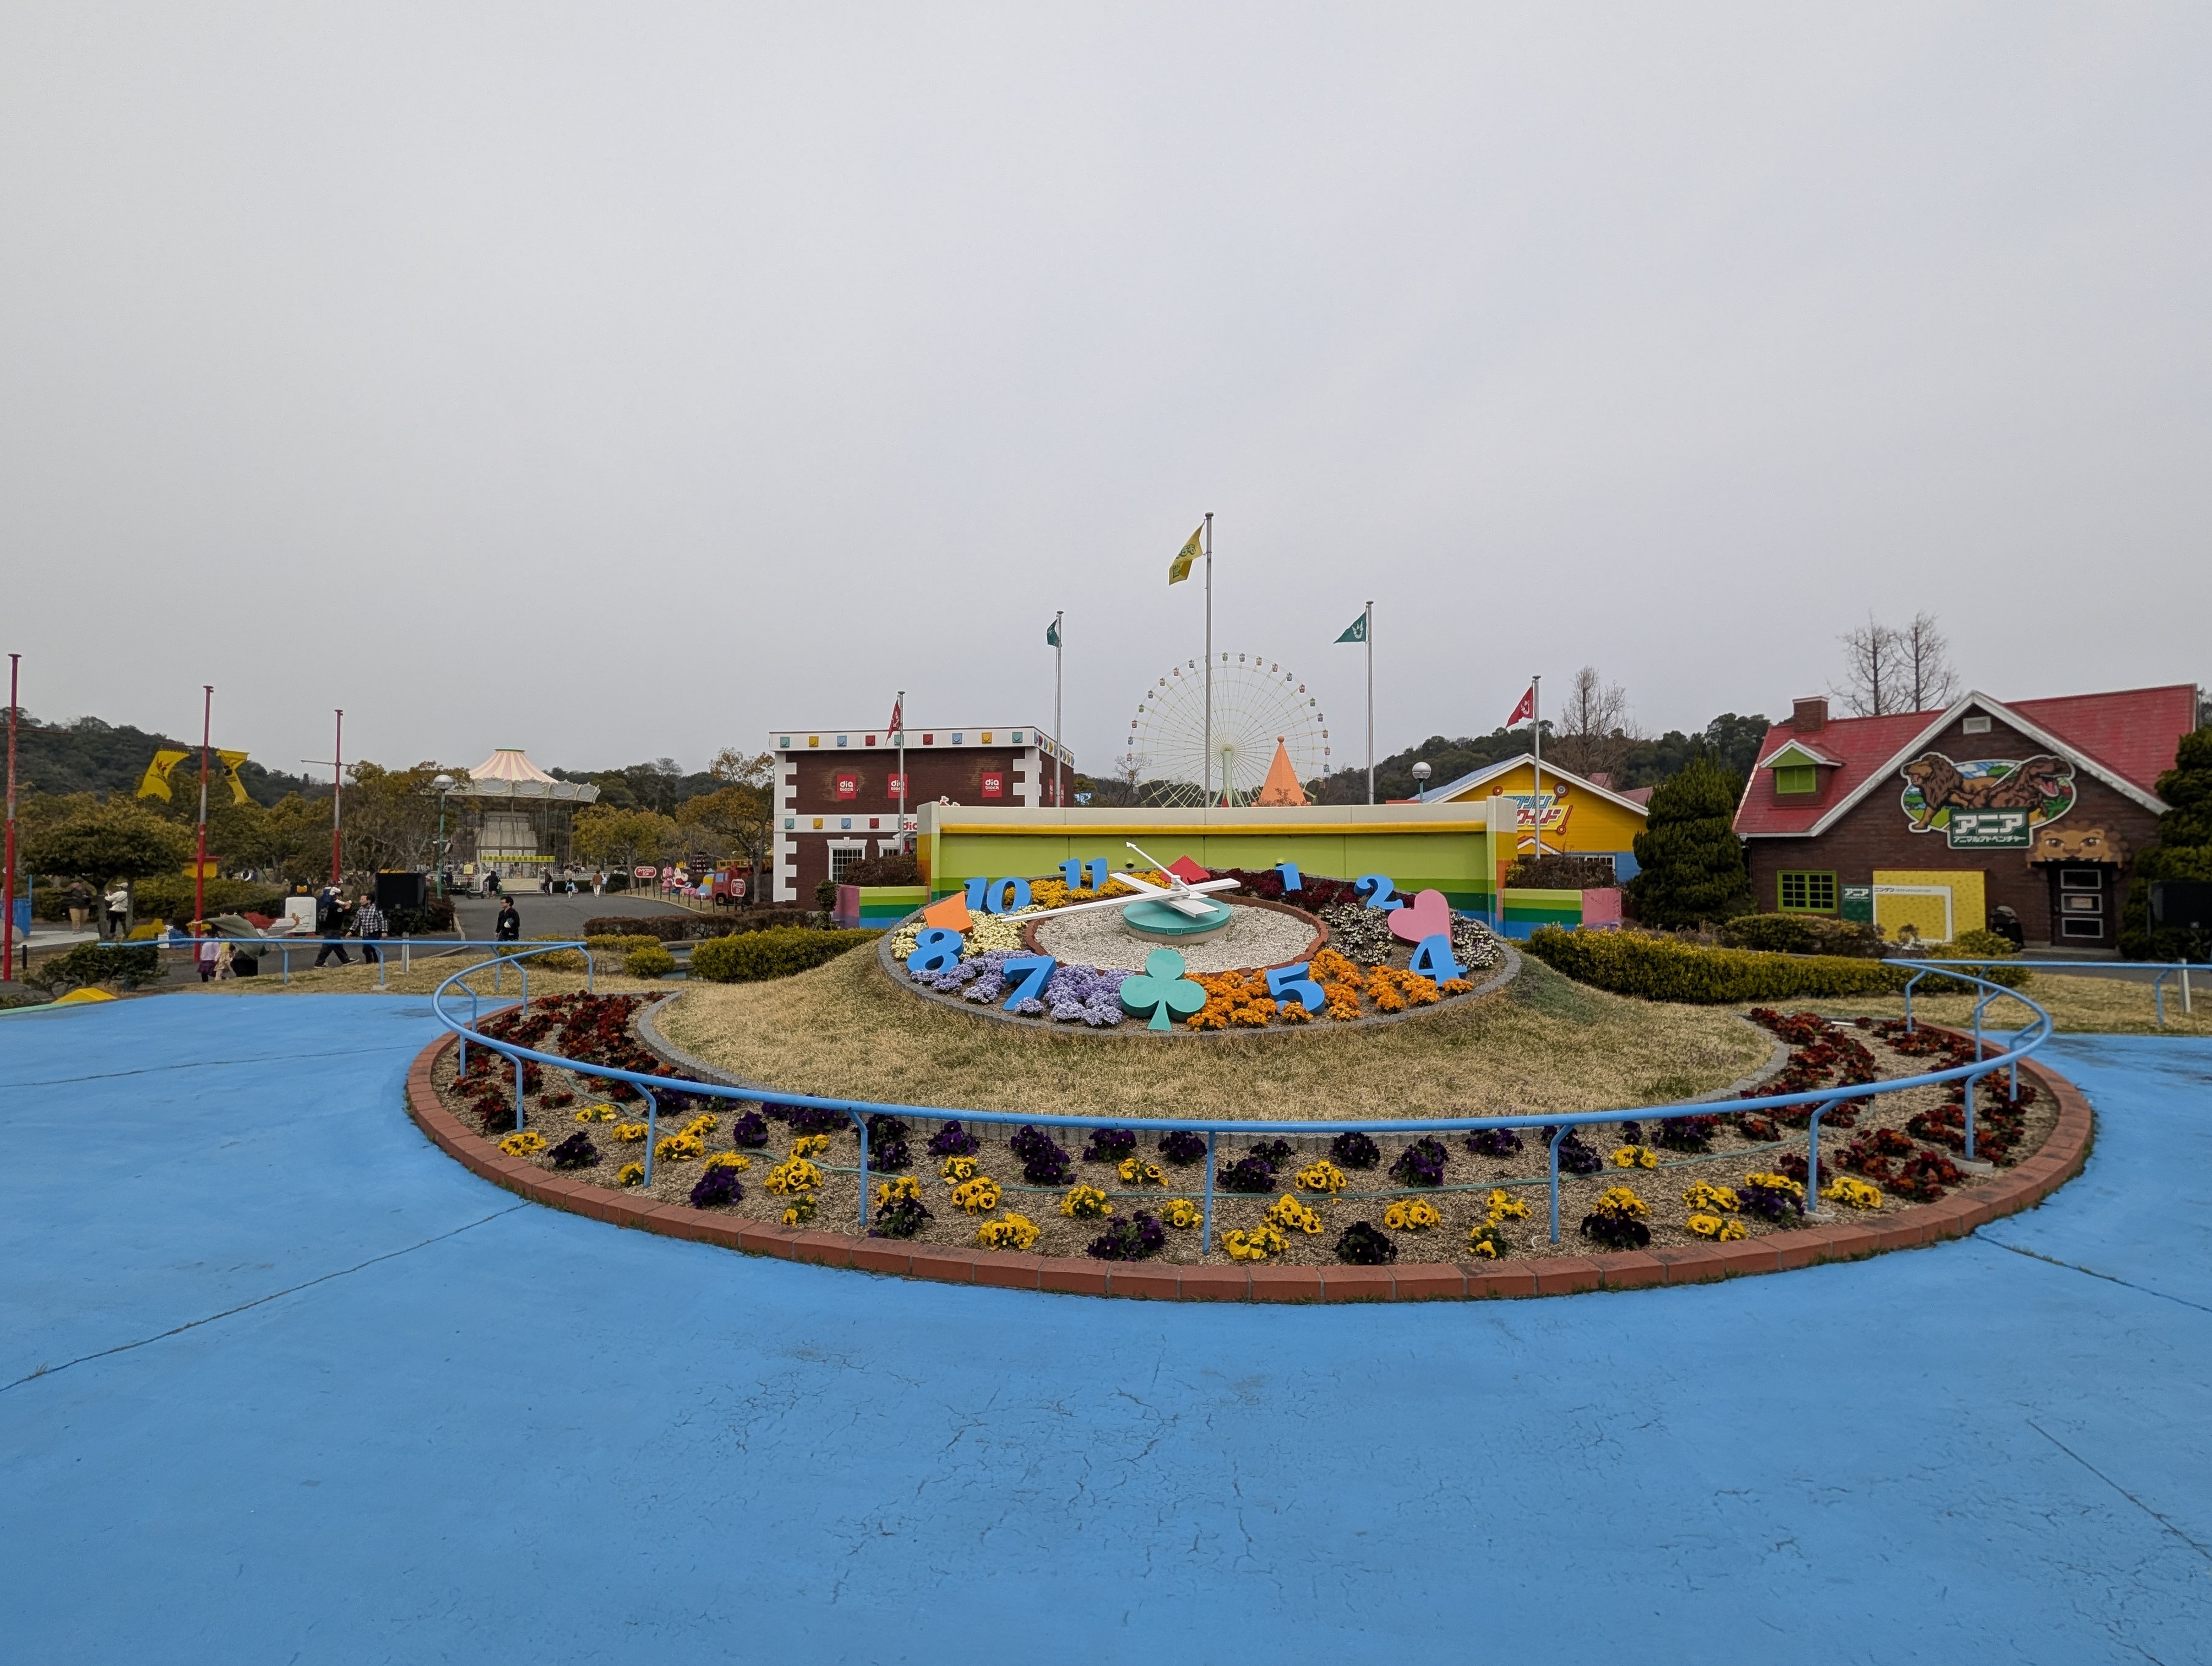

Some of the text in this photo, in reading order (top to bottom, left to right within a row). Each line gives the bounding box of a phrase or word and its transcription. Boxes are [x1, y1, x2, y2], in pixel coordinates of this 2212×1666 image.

[1953, 813, 2024, 834] アニア
[1058, 857, 1108, 893] 11
[1275, 862, 1302, 893] 1
[1354, 874, 1404, 911] 2
[964, 876, 1033, 916] 10
[906, 927, 964, 976] 8
[1409, 933, 1468, 987] 4
[1003, 956, 1057, 1011] 7
[1265, 961, 1326, 1016] 5
